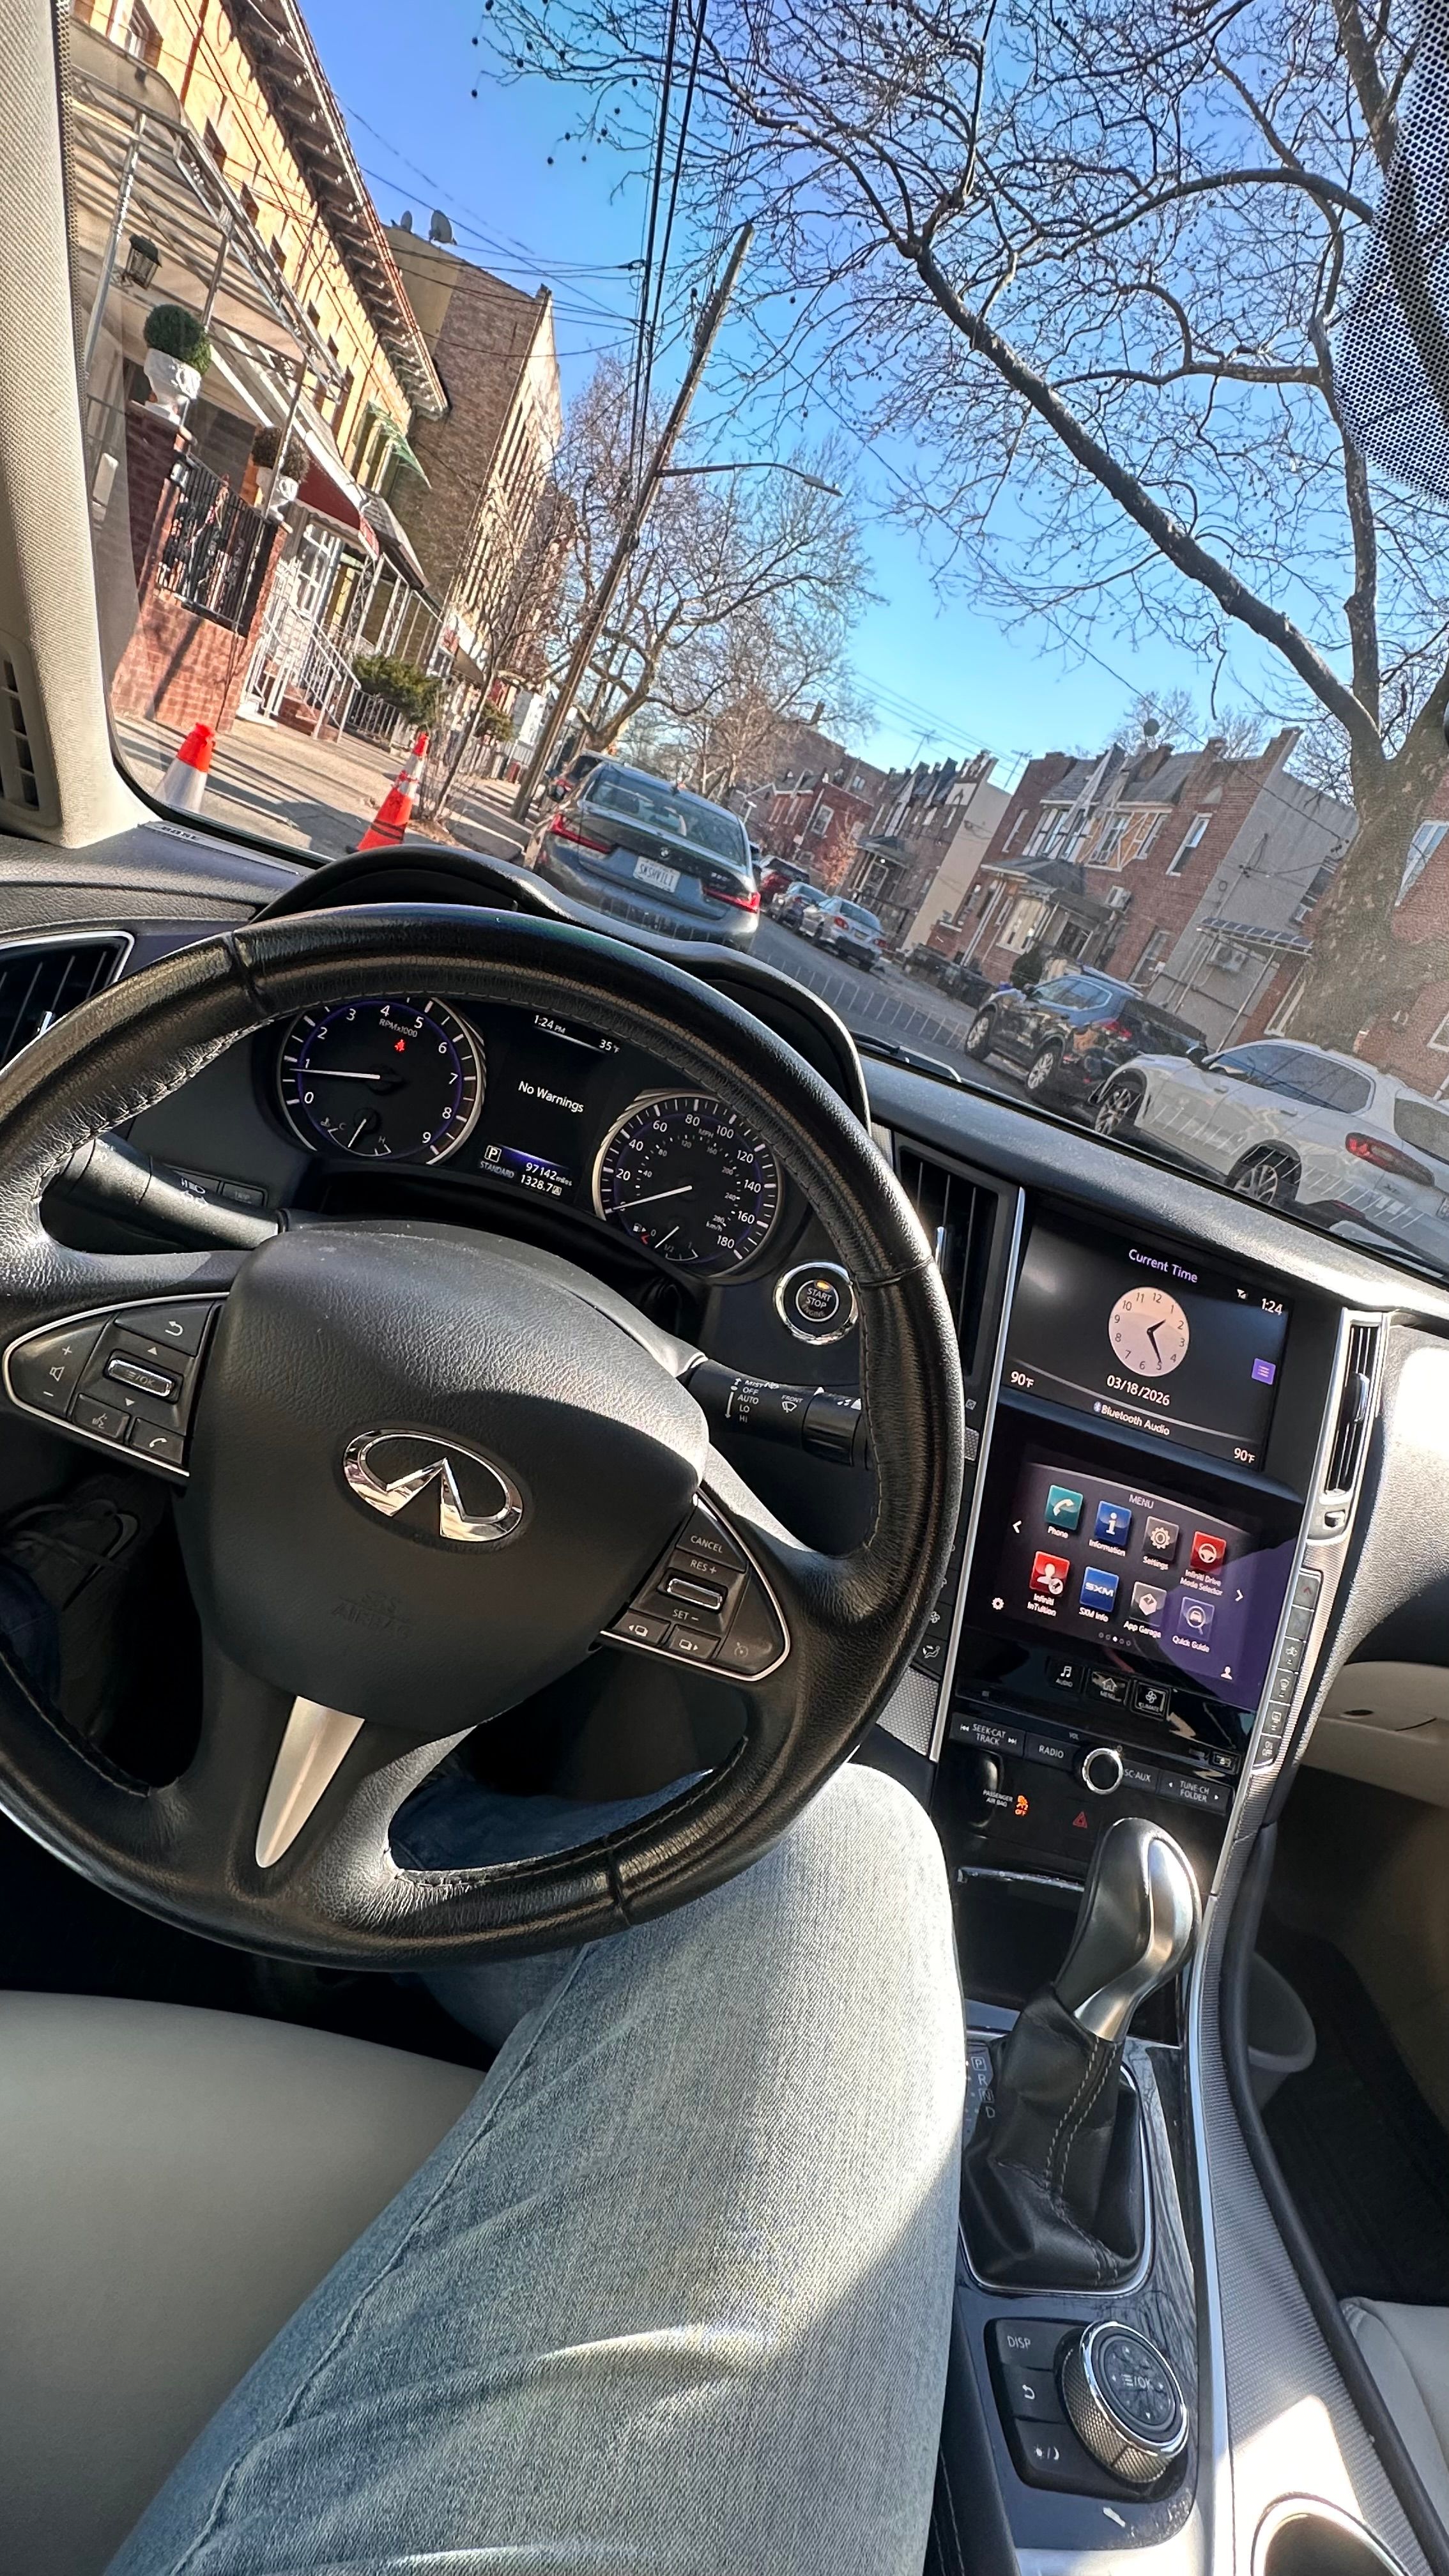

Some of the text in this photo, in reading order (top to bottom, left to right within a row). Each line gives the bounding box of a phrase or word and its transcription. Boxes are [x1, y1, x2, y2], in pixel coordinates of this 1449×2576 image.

[346, 1008, 356, 1022] 3
[381, 1005, 390, 1016] 4
[414, 1017, 424, 1029] 5
[534, 1015, 565, 1034] 1:24 PM
[318, 1027, 328, 1039] 2
[438, 1042, 447, 1054] 6
[305, 1059, 310, 1068] 1
[448, 1073, 458, 1084] 7
[304, 1091, 314, 1104] 0
[518, 1081, 584, 1113] No Warnings
[442, 1107, 452, 1119] 8
[653, 1120, 668, 1133] 60
[686, 1114, 700, 1127] 80
[422, 1131, 431, 1144] 9
[698, 1129, 714, 1138] MPH
[716, 1125, 734, 1139] 100
[629, 1138, 643, 1151] 40
[681, 1140, 692, 1149] 120
[489, 1148, 498, 1159] P
[658, 1149, 667, 1157] 80
[737, 1150, 753, 1163] 120
[480, 1161, 514, 1178] STANDARD
[616, 1169, 631, 1181] 20
[643, 1170, 652, 1178] 40
[520, 1174, 552, 1192] 1328.7
[744, 1179, 761, 1193] 140
[737, 1211, 755, 1224] 160
[706, 1222, 723, 1232] km/h
[717, 1235, 735, 1248] 180
[1129, 1248, 1198, 1284] Current Time
[807, 1287, 832, 1302] START
[1136, 1292, 1145, 1303] 11
[1152, 1292, 1162, 1303] 12
[806, 1297, 827, 1308] STOP
[1123, 1300, 1132, 1311] 10
[1261, 1298, 1284, 1316] 1:24
[801, 1303, 825, 1317] ENGINE
[1170, 1304, 1174, 1314] 1
[1114, 1314, 1121, 1324] 9
[1177, 1321, 1184, 1331] 2
[1115, 1333, 1122, 1343] 8
[1179, 1338, 1185, 1347] 3
[1125, 1350, 1132, 1360] 7
[1170, 1353, 1177, 1363] 4
[1139, 1361, 1146, 1370] 6
[1156, 1361, 1162, 1371] 5
[742, 1386, 759, 1395] OFF
[1107, 1374, 1170, 1407] 03/18/2026
[737, 1394, 759, 1404] AUTO
[781, 1395, 804, 1403] FRONT
[739, 1404, 749, 1413] LO
[739, 1414, 747, 1423] HI
[1101, 1404, 1170, 1436] Bluetooth Audio
[1129, 1494, 1154, 1508] MENU
[1048, 1526, 1069, 1538] Phone
[690, 1535, 723, 1554] CANCEL
[1089, 1539, 1126, 1557] Information
[690, 1560, 707, 1572] RES
[1142, 1556, 1169, 1570] Settings
[1185, 1569, 1222, 1587] Infiniti Drive
[1085, 1582, 1114, 1597] SXM
[1180, 1577, 1223, 1596] Mode Selector
[1033, 1593, 1054, 1606] Infiniti
[673, 1609, 689, 1621] SET
[1078, 1607, 1109, 1623] SXM Info
[1123, 1621, 1162, 1638] App Garage
[1172, 1636, 1209, 1653] Quick Guide
[1055, 1678, 1073, 1687] AUDIO
[976, 1733, 1000, 1745] TRACK
[1038, 1745, 1064, 1758] RADIO
[983, 1790, 1013, 1802] PASSENGER
[1180, 1789, 1207, 1803] FOLDER
[975, 2059, 982, 2069] P
[978, 2074, 988, 2086] R
[982, 2090, 991, 2101] N
[986, 2106, 995, 2119] D
[1007, 2336, 1031, 2350] DISP
